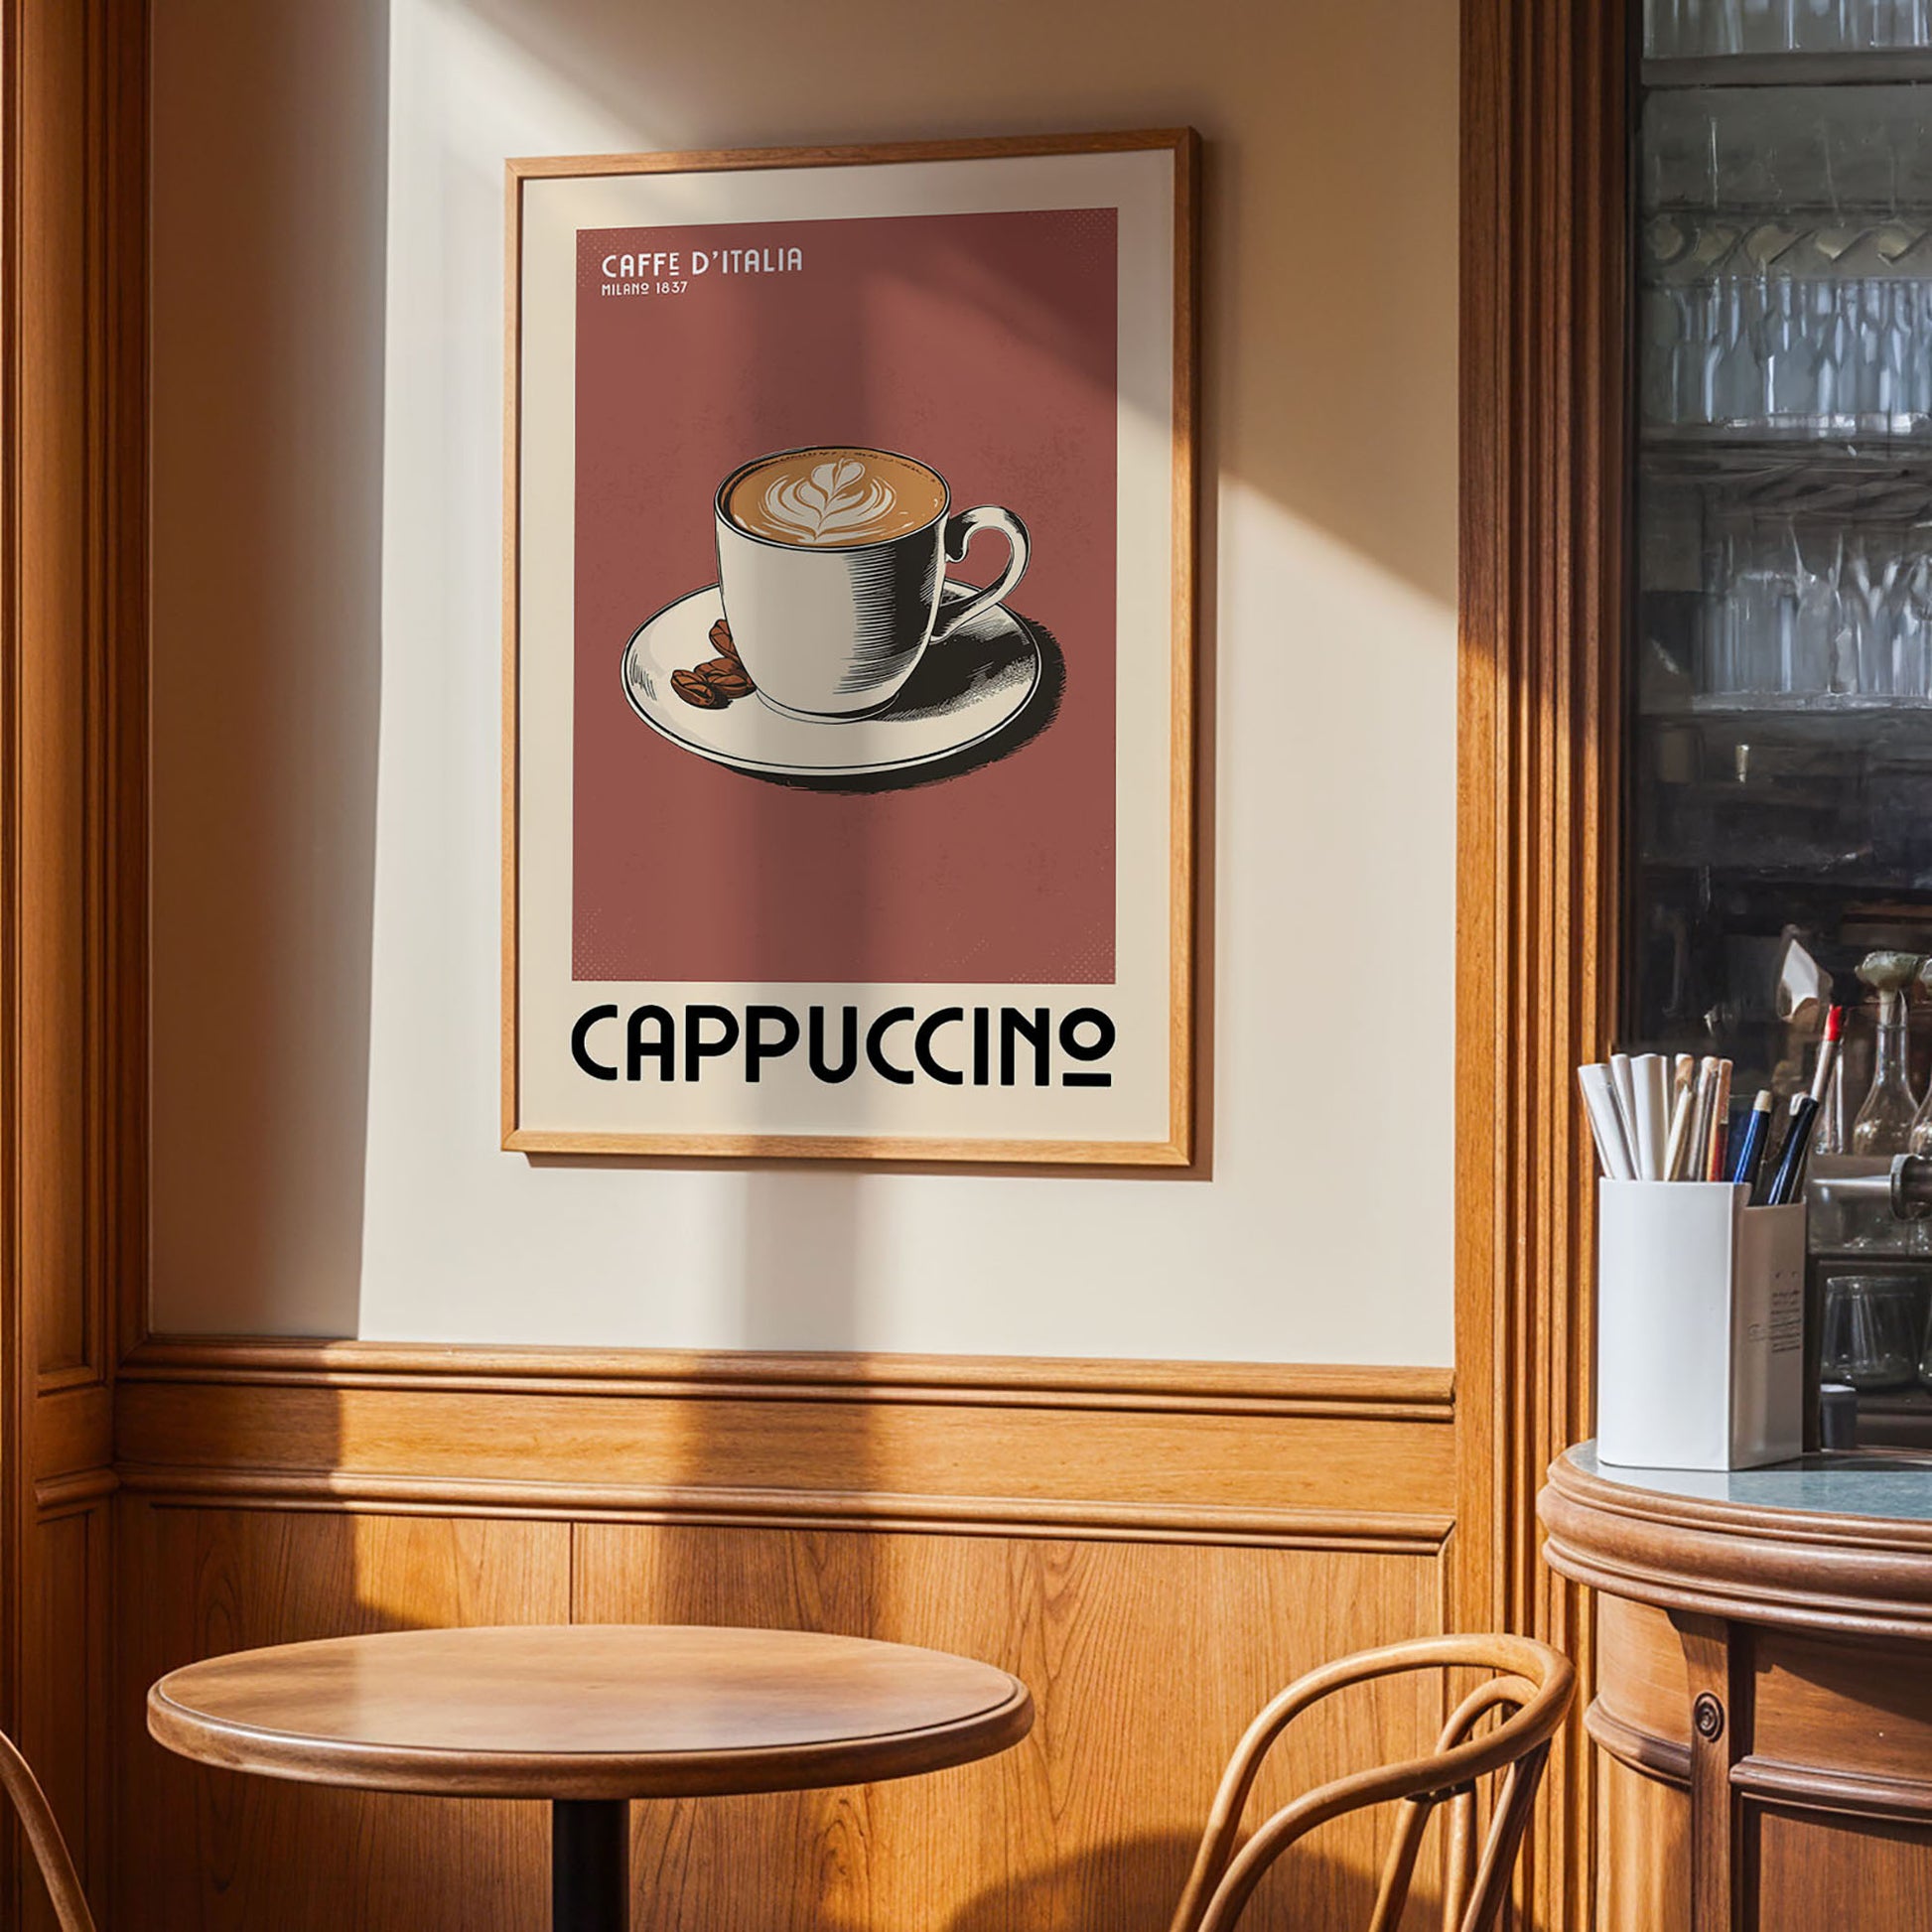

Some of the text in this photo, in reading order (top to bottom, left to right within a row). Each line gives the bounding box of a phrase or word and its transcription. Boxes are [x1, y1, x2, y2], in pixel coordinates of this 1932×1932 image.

[602, 247, 803, 278] CAFFE D’ITALIA
[601, 281, 688, 297] MILANO 1837
[571, 1004, 1116, 1087] CAPPUCCINO
